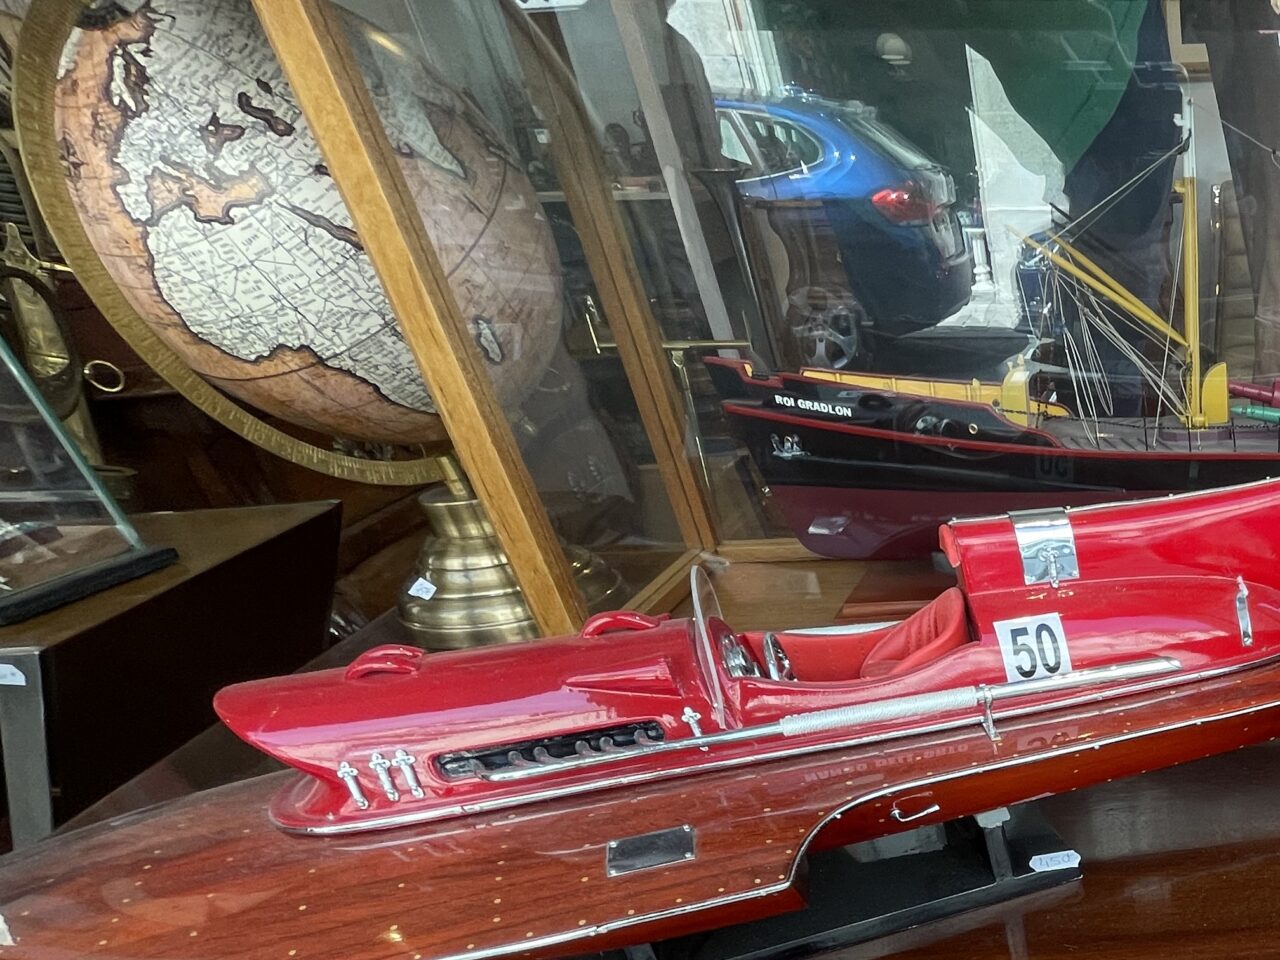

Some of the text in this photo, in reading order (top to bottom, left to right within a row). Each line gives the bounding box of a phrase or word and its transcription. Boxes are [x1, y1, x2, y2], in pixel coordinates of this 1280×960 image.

[774, 394, 852, 417] ROI GRADLON
[1010, 623, 1061, 678] 50
